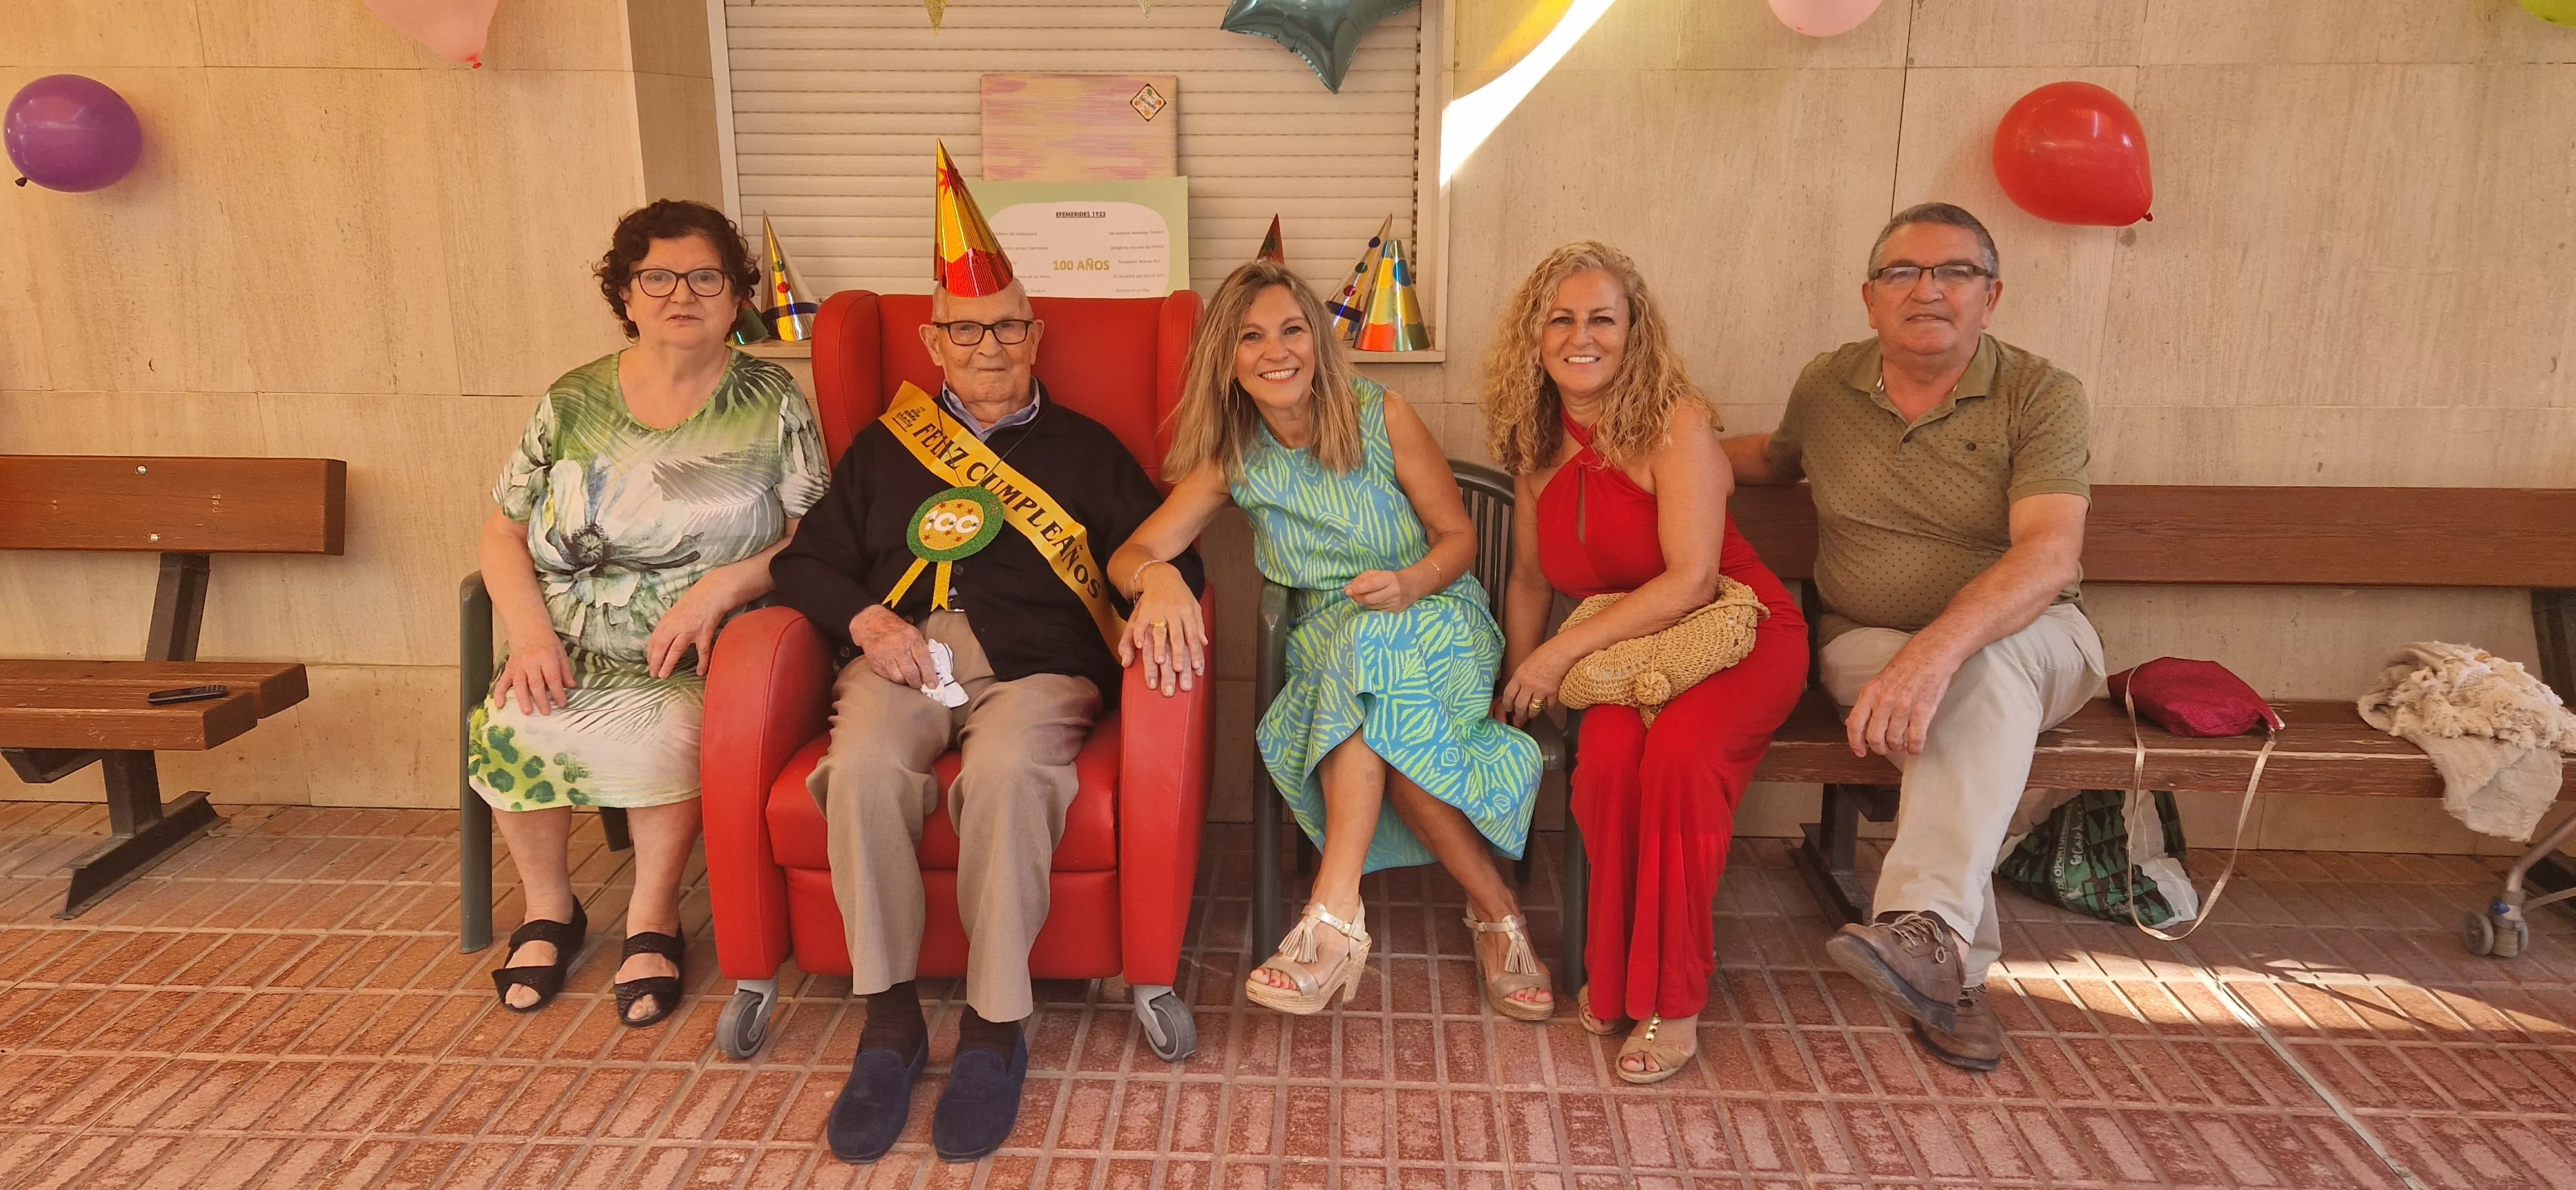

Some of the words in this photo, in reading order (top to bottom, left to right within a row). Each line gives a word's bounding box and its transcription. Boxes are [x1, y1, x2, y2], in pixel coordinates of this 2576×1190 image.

[1053, 260, 1074, 270] 100
[1077, 258, 1110, 271] AÑOS
[913, 422, 970, 471] FELIZ
[966, 461, 1101, 599] CUMPLEAÑOS
[2055, 878, 2065, 890] DE
